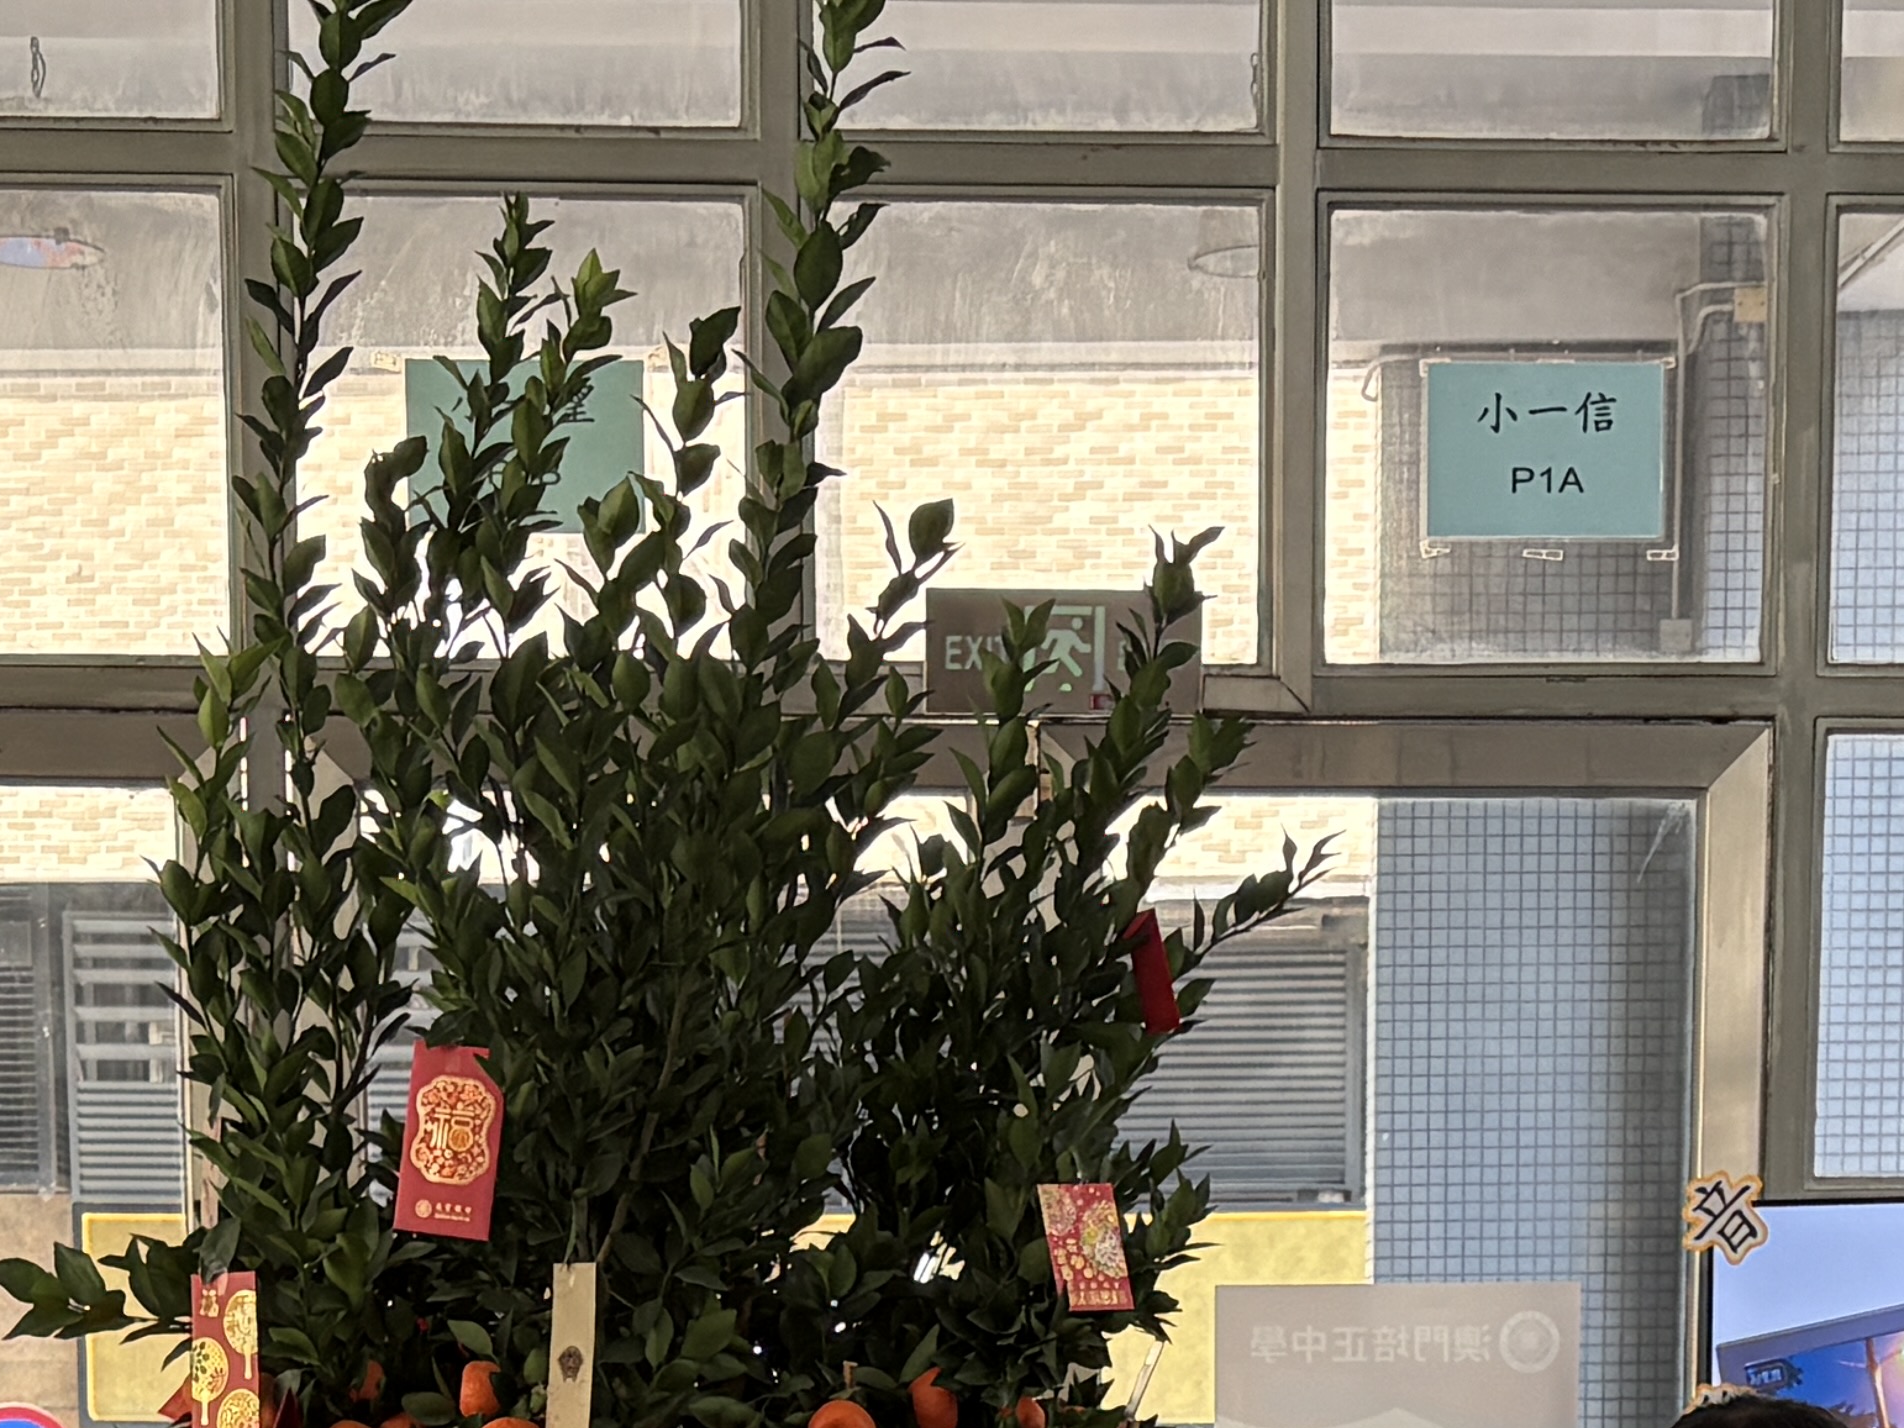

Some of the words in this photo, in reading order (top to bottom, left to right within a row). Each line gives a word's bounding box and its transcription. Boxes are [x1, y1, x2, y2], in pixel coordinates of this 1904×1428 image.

[1476, 391, 1619, 435] 小一信
[1509, 465, 1586, 496] P1A
[424, 1107, 475, 1152] 福
[1693, 1179, 1759, 1256] 音
